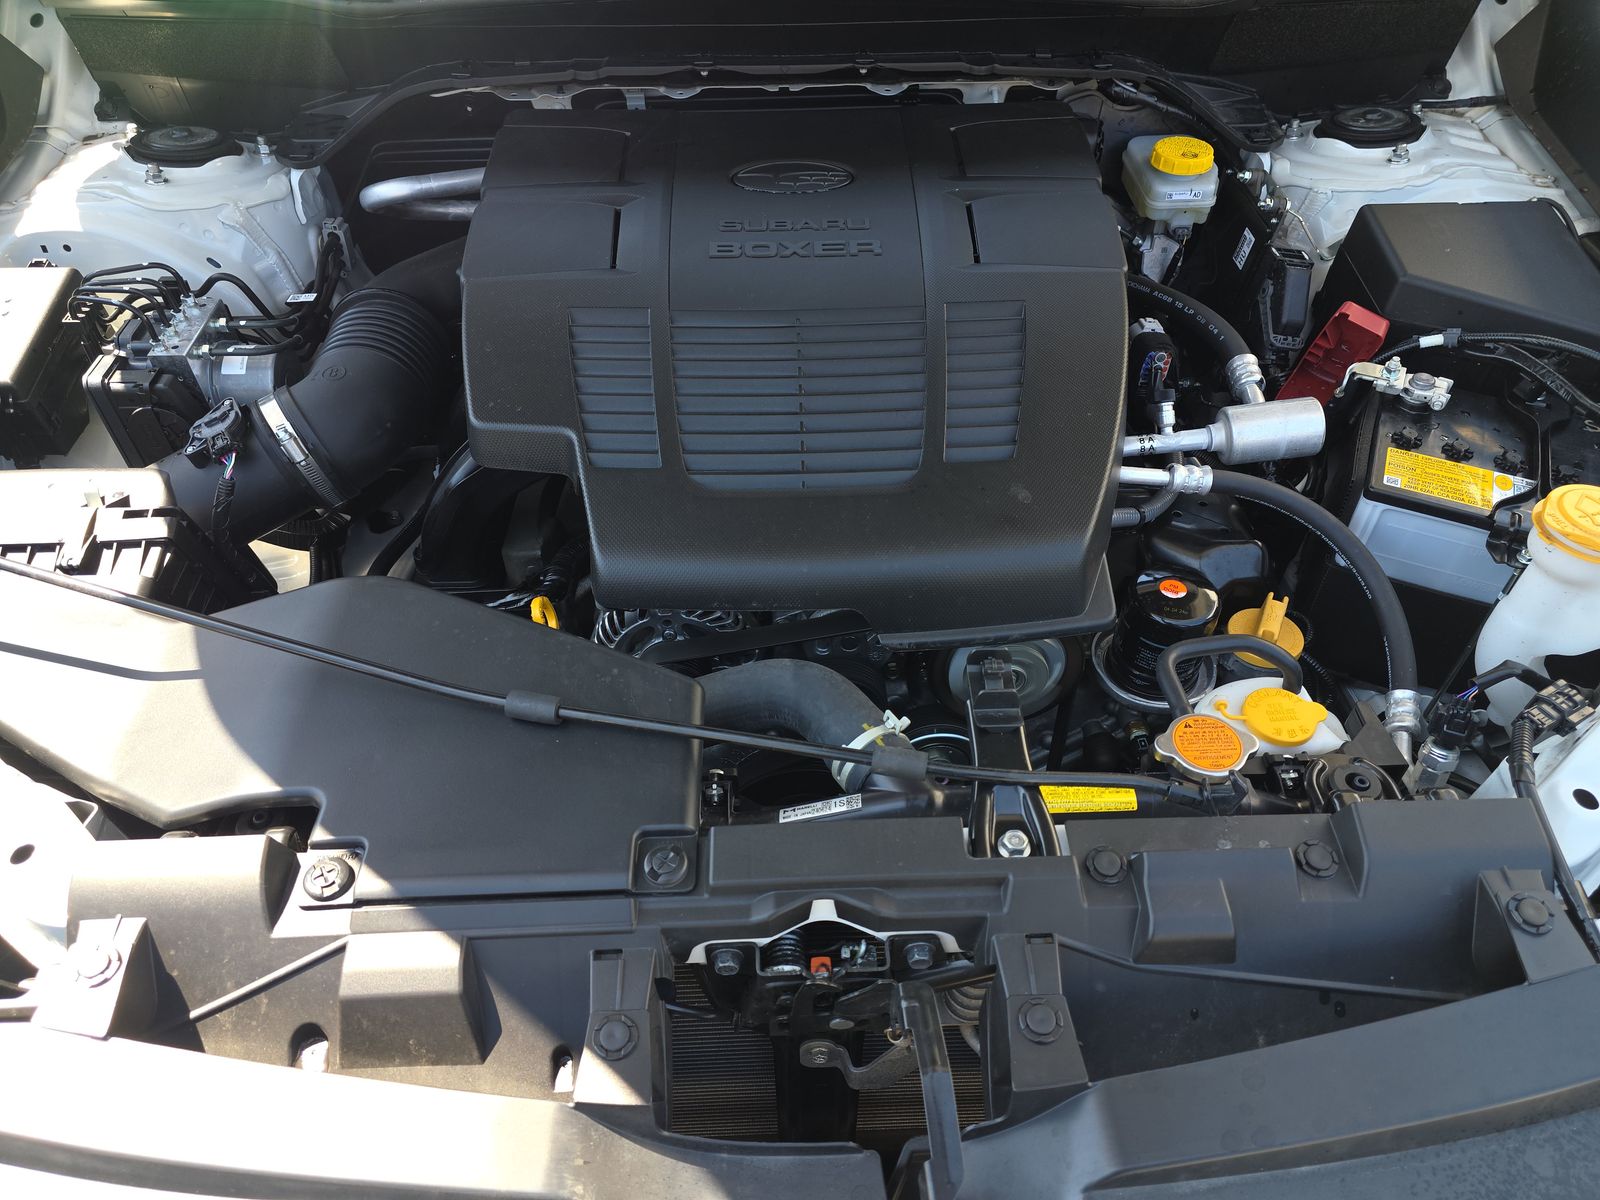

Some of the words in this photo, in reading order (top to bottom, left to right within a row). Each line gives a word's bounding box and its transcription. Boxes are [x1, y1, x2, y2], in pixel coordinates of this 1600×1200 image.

[719, 215, 871, 232] SUBARU
[708, 239, 883, 259] BOXER
[1389, 448, 1419, 459] DANGER
[1388, 461, 1416, 472] POISON
[1437, 491, 1451, 499] CCA
